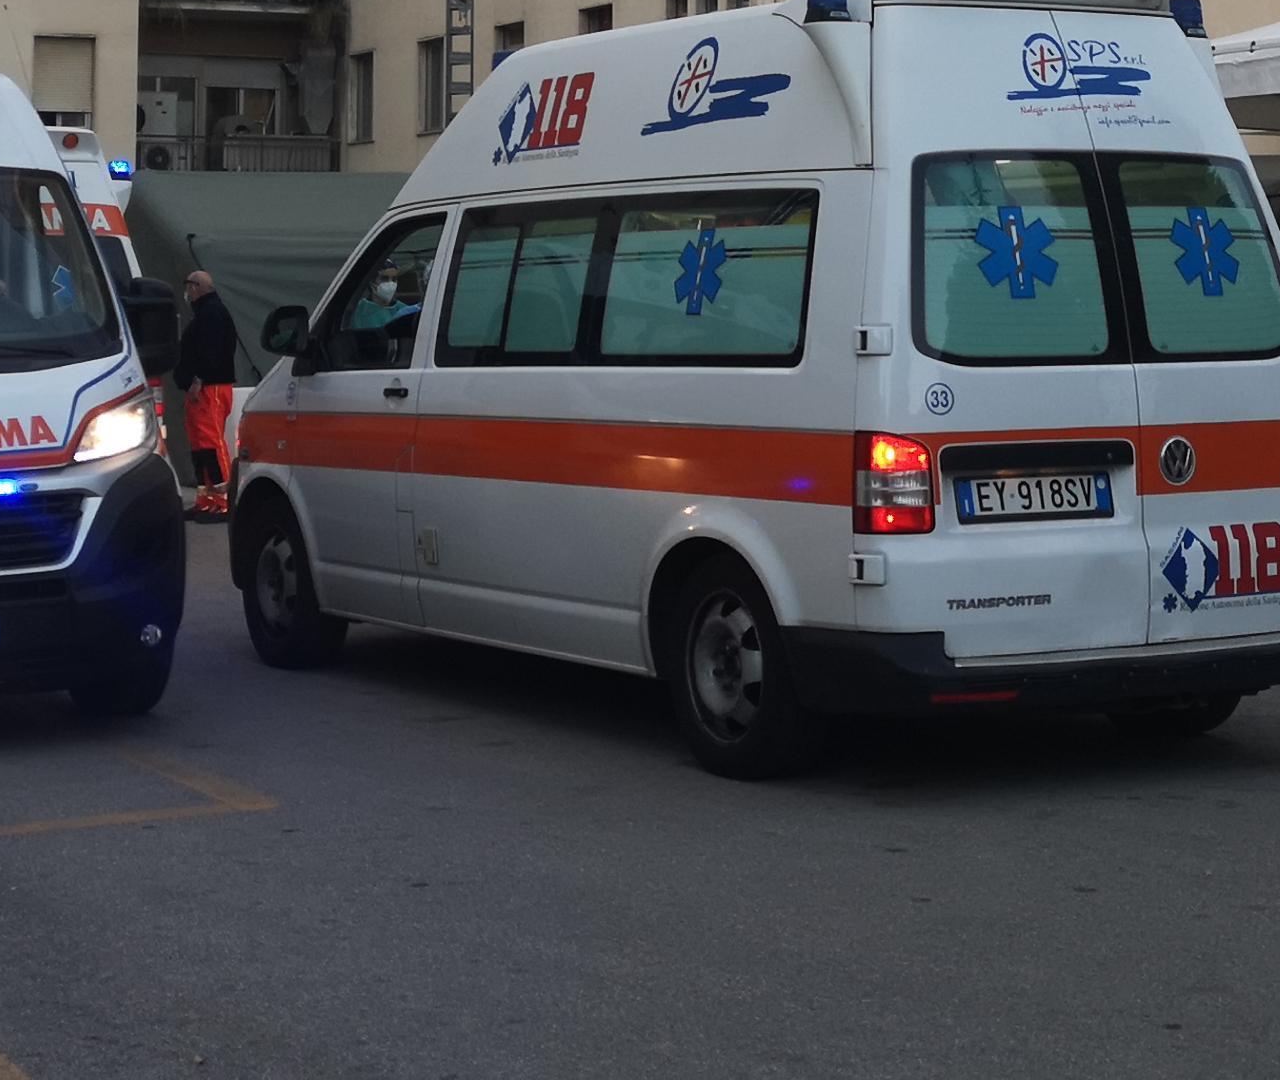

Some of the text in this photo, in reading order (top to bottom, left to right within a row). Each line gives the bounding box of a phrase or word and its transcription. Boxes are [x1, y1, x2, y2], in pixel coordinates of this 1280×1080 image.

[1067, 40, 1121, 64] SPS
[527, 71, 595, 149] 118
[930, 390, 950, 409] 33
[976, 477, 1094, 512] EY 918SV
[946, 594, 1052, 610] TRANSPORTER
